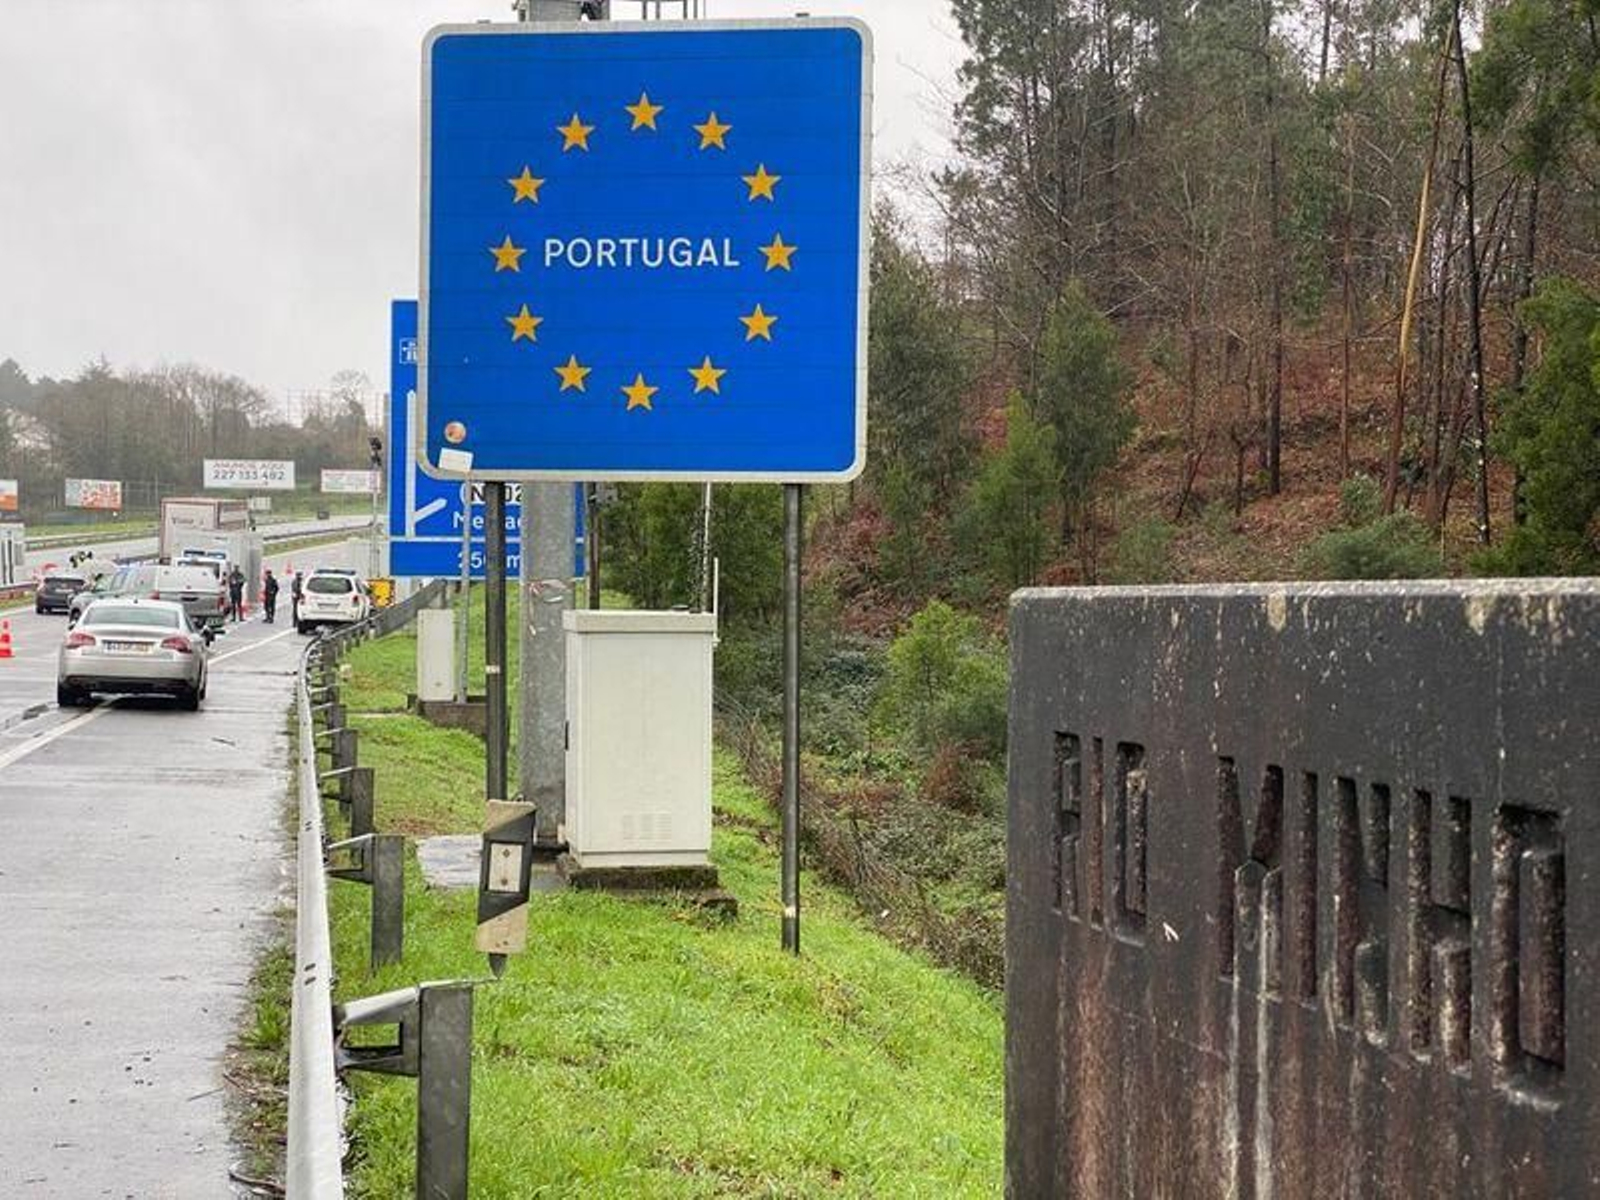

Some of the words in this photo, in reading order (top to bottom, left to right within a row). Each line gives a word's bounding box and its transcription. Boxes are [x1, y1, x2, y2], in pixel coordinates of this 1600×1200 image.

[544, 237, 740, 268] PORTUGAL
[1053, 730, 1148, 946] RIO
[1217, 755, 1567, 1111] MINHO
